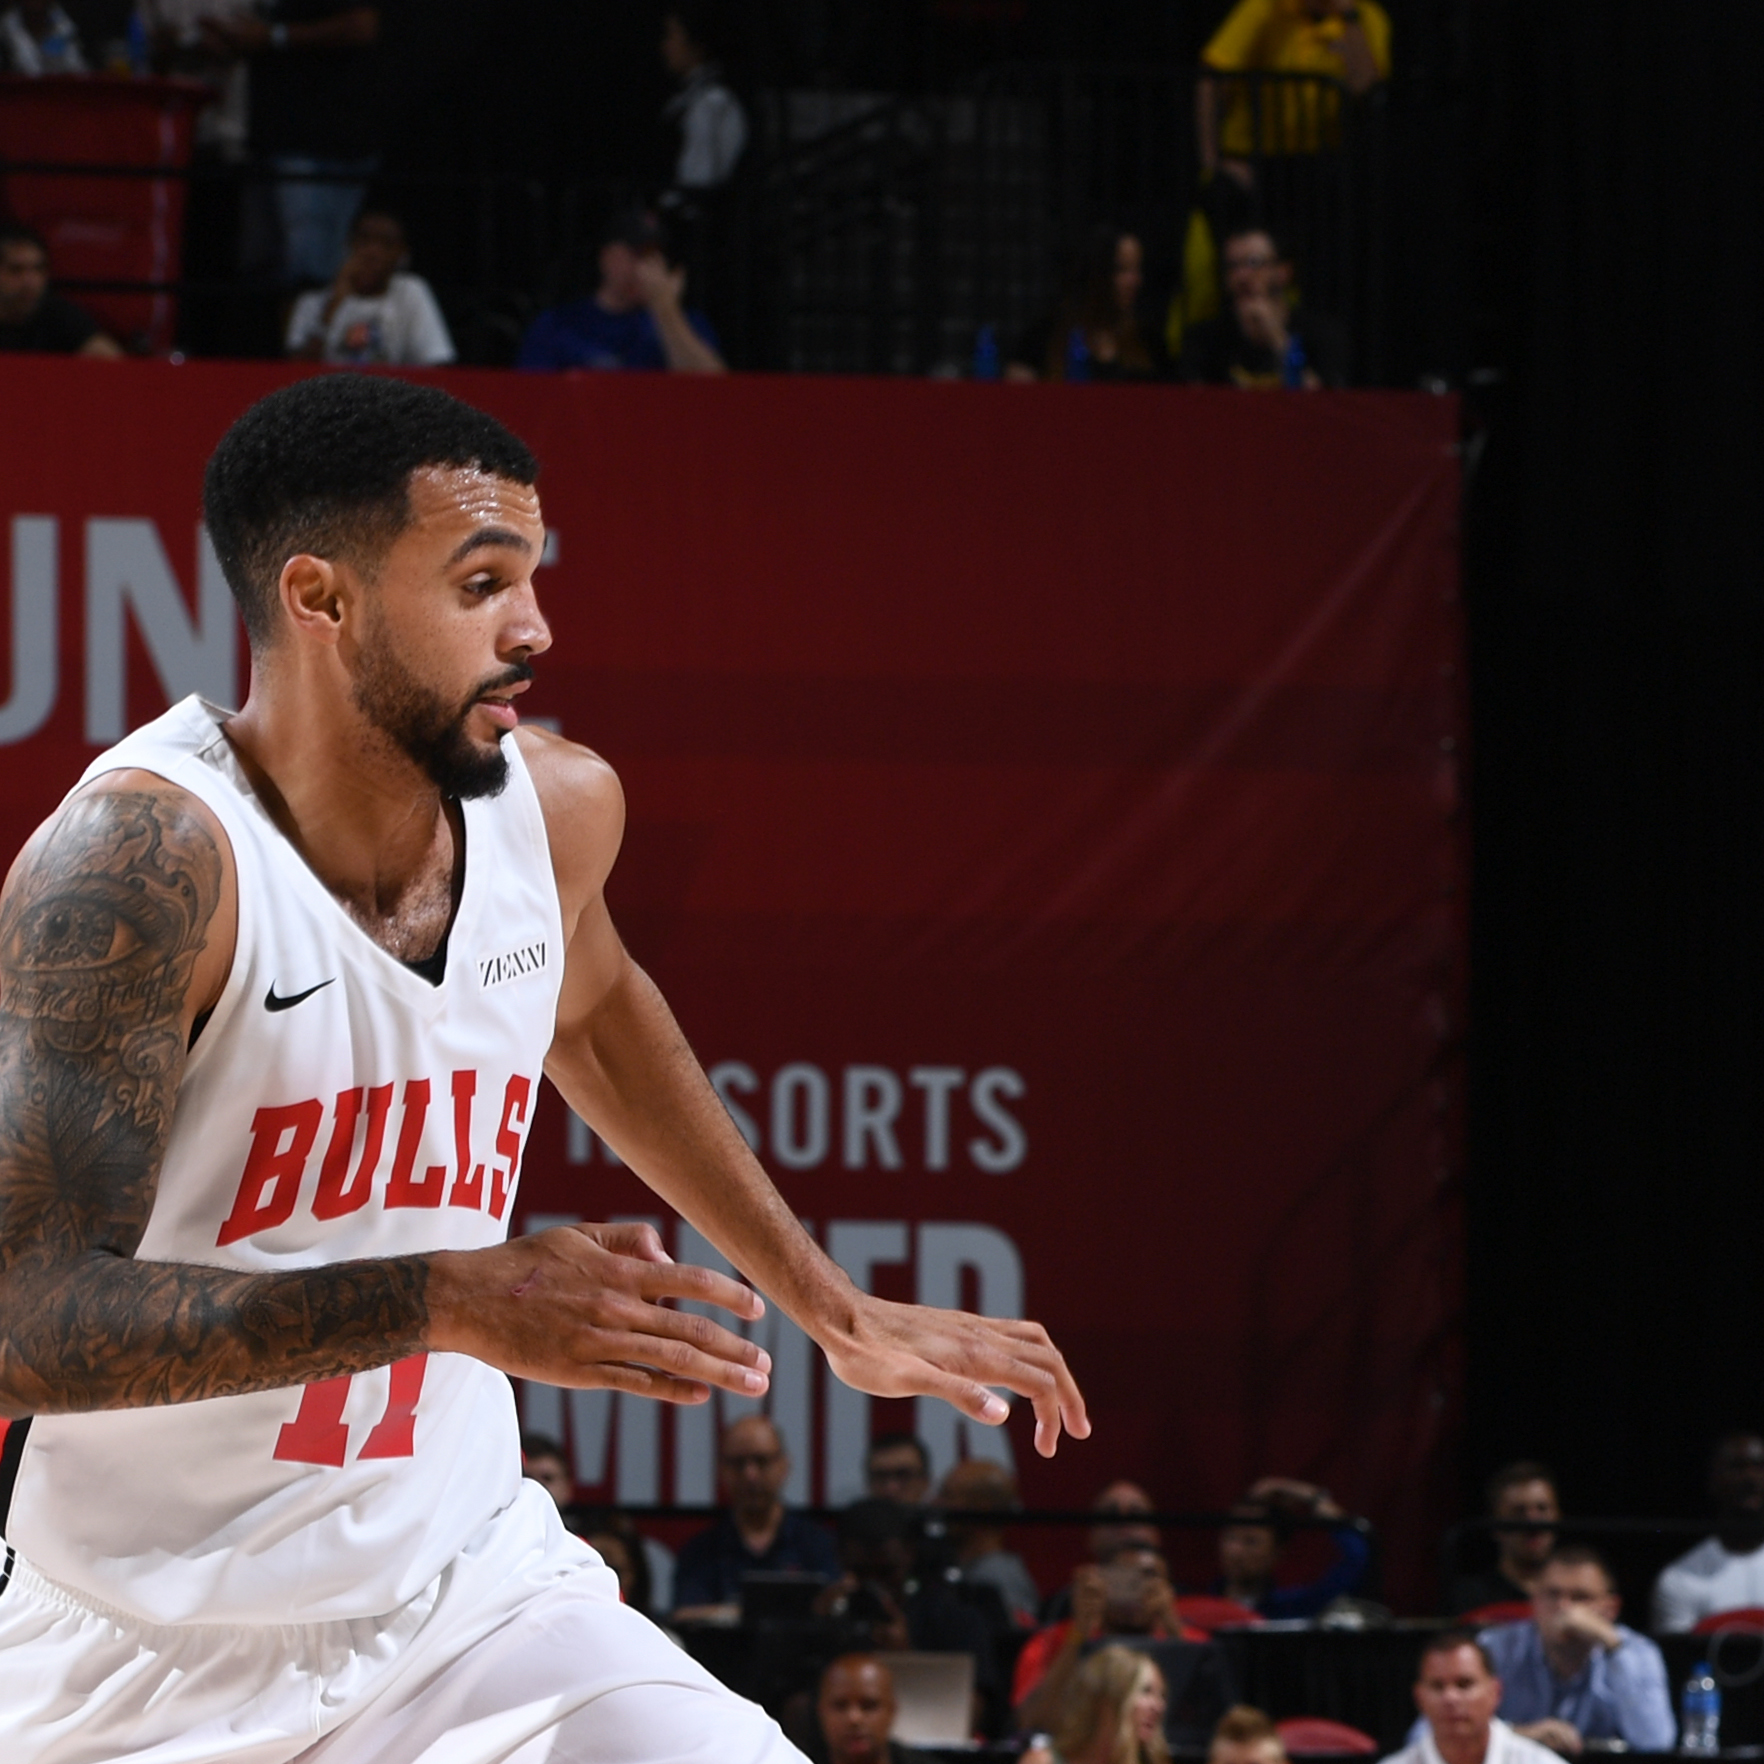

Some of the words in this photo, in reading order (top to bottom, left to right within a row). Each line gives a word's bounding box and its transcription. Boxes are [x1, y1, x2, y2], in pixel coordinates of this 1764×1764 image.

[480, 942, 545, 987] ZENNI
[215, 1069, 531, 1248] BULLS
[567, 1061, 1028, 1173] SORTS
[520, 1214, 1026, 1510] MMER
